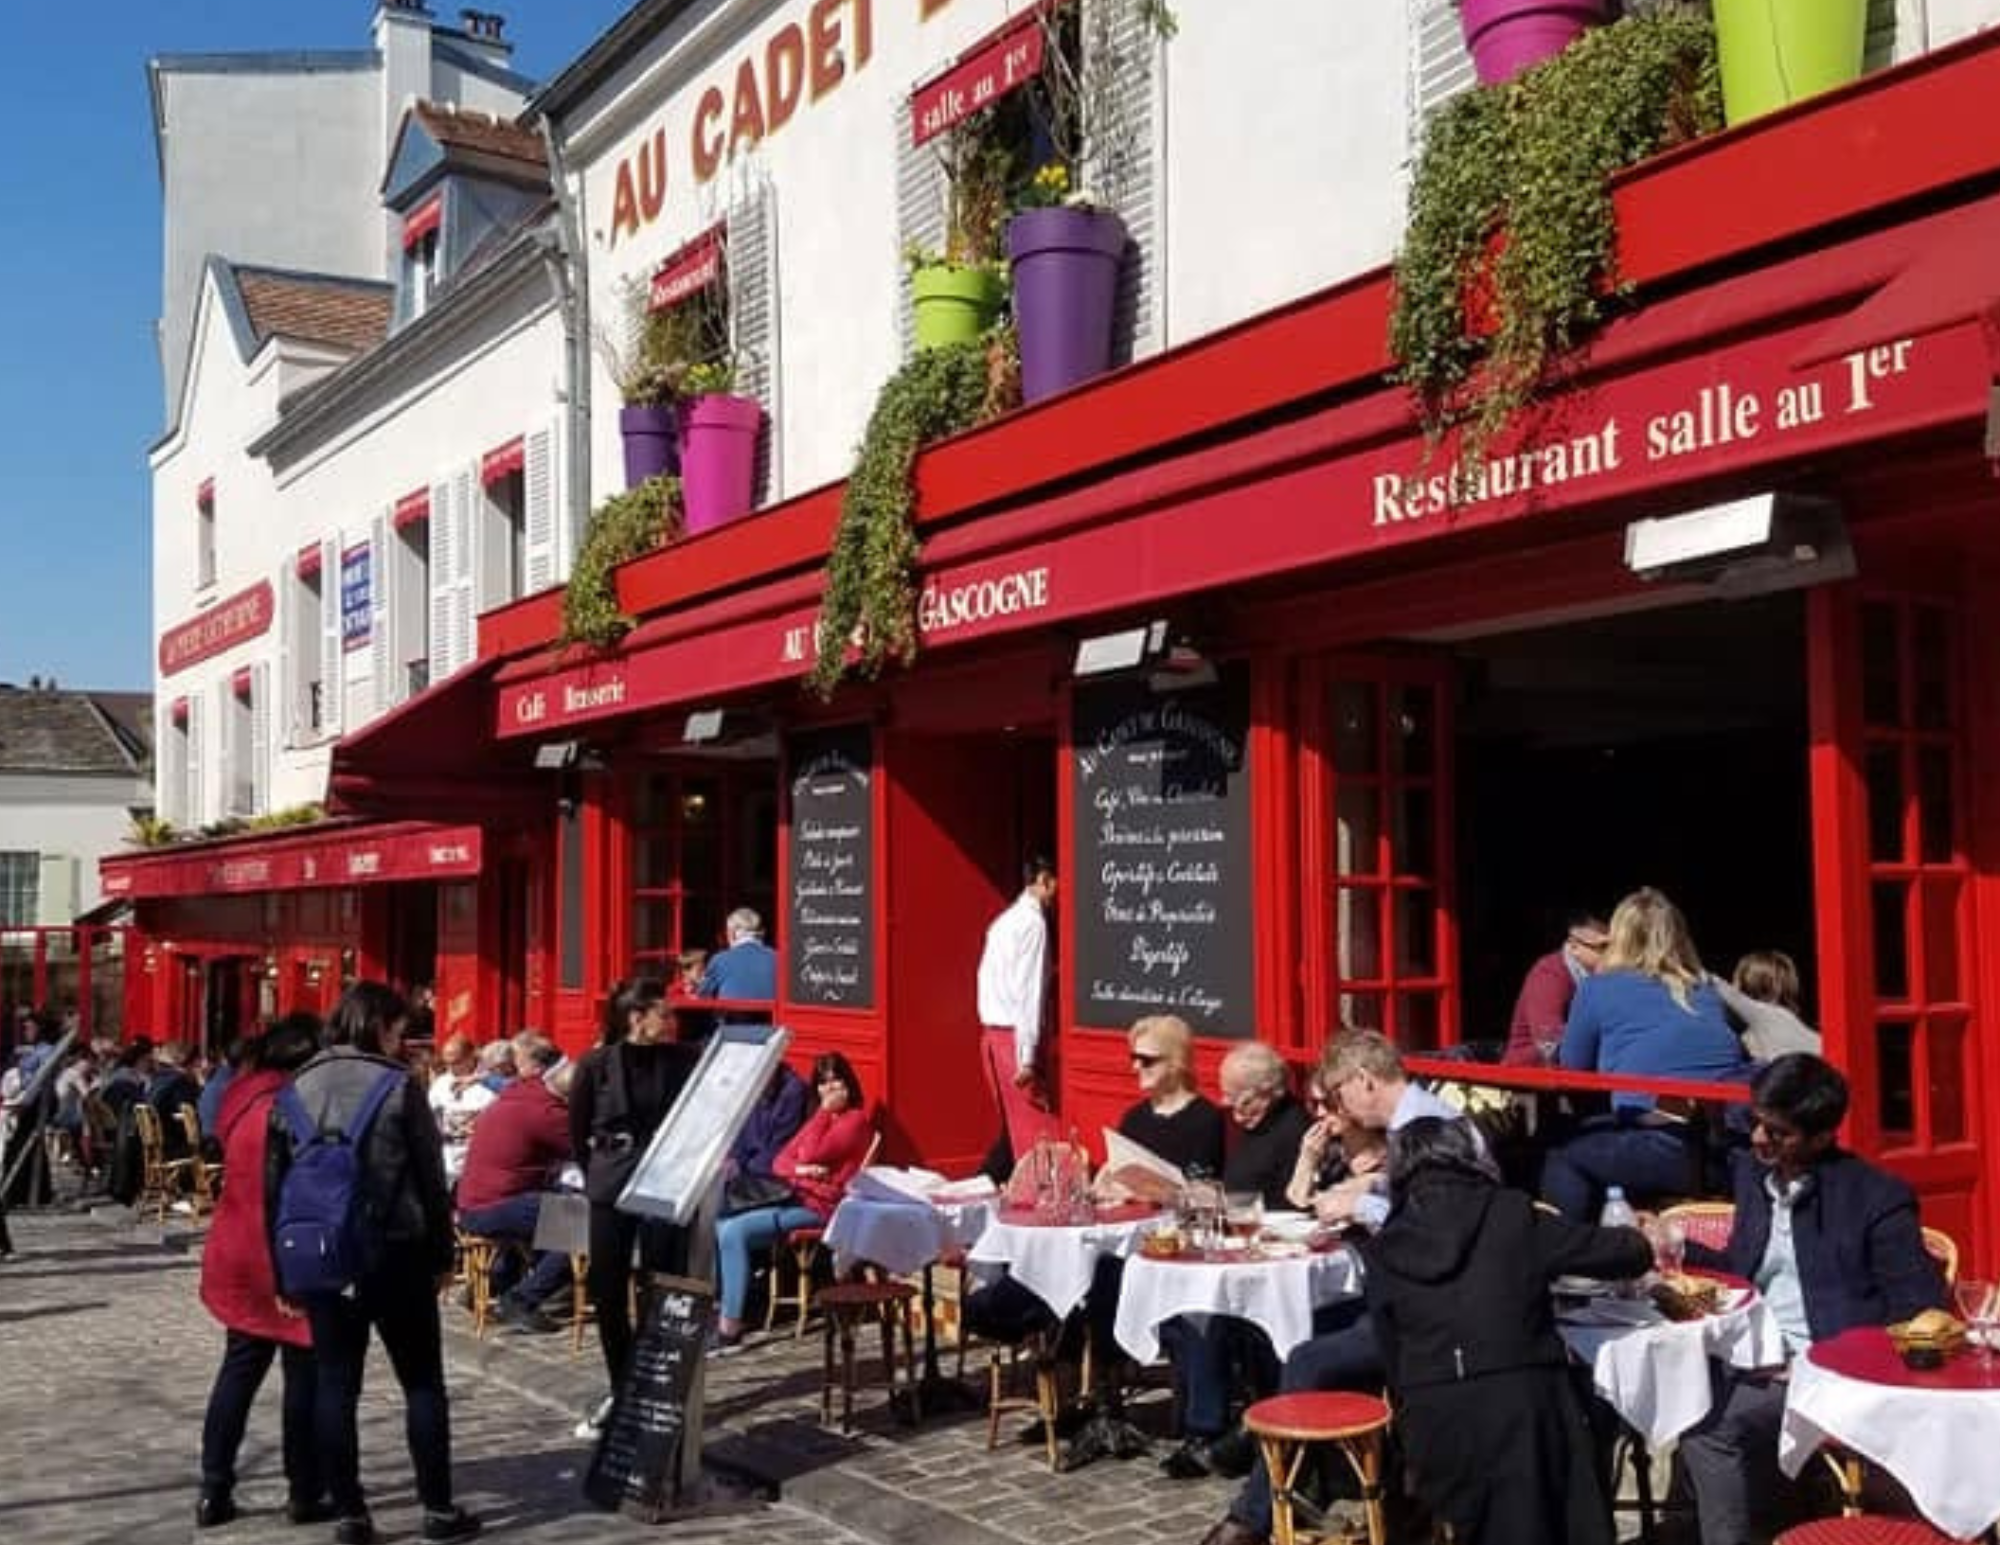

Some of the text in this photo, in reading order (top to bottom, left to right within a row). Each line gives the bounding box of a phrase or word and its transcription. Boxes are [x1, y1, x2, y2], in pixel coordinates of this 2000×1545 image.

[923, 89, 964, 137] salle
[973, 73, 994, 104] au
[610, 126, 667, 249] AU
[1647, 383, 1761, 461] salle
[1776, 382, 1824, 430] au
[1841, 339, 1913, 413] 1er
[917, 566, 1049, 633] GASCOGNE
